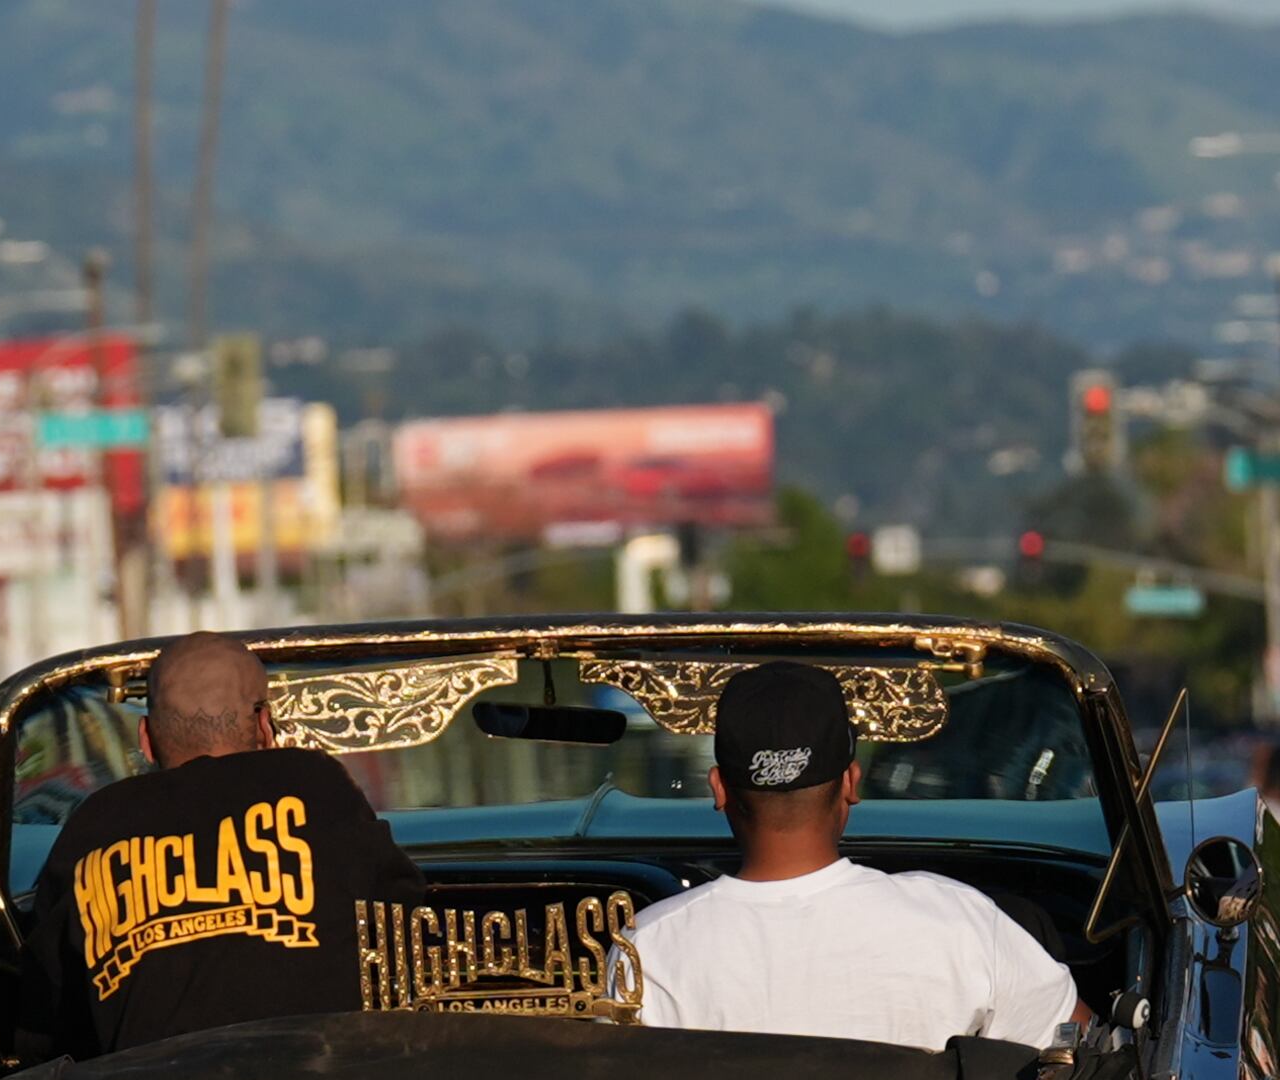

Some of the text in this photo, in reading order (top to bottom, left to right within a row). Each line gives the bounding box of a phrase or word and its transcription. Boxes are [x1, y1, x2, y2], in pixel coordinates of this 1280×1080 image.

[73, 795, 316, 968] HIGHCLASS
[135, 909, 247, 950] LOS ANGELES
[355, 890, 645, 1013] HIGHCLASS
[438, 997, 569, 1014] LOS ANGELES
